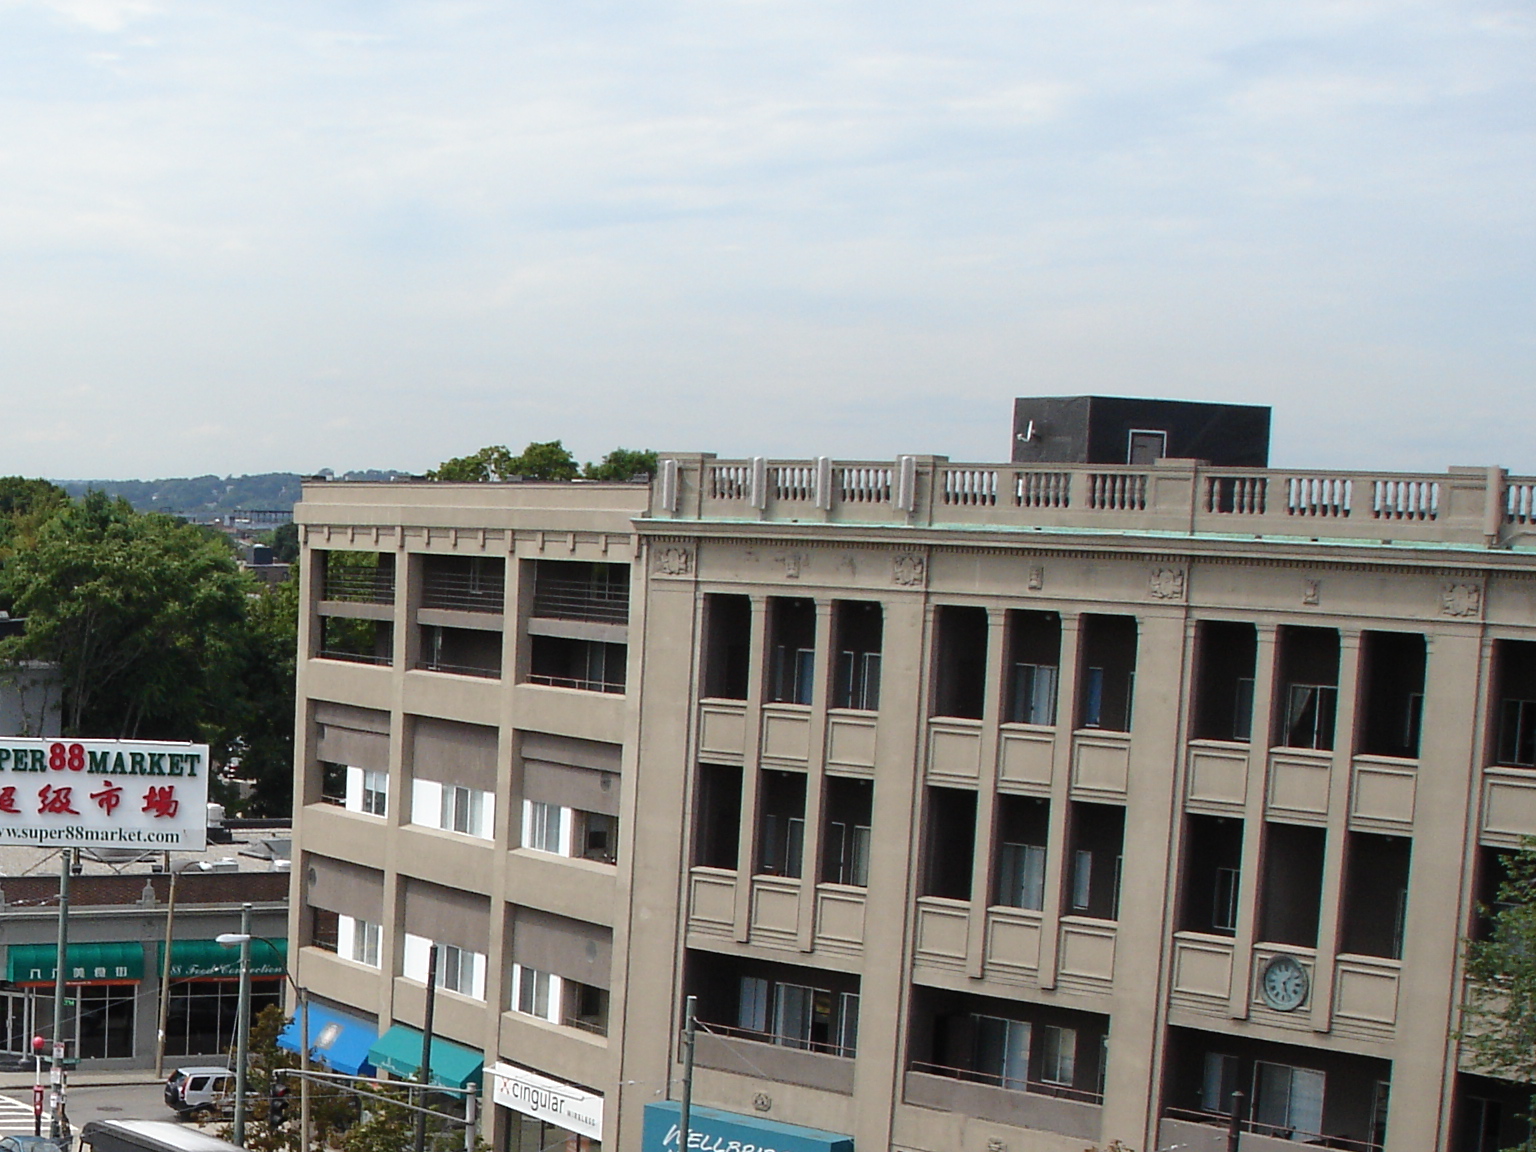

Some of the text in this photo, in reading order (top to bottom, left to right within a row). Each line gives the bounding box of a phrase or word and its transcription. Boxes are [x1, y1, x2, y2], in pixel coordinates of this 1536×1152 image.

[49, 742, 85, 772] 88
[87, 750, 201, 777] MARKET
[512, 1082, 565, 1114] cingular
